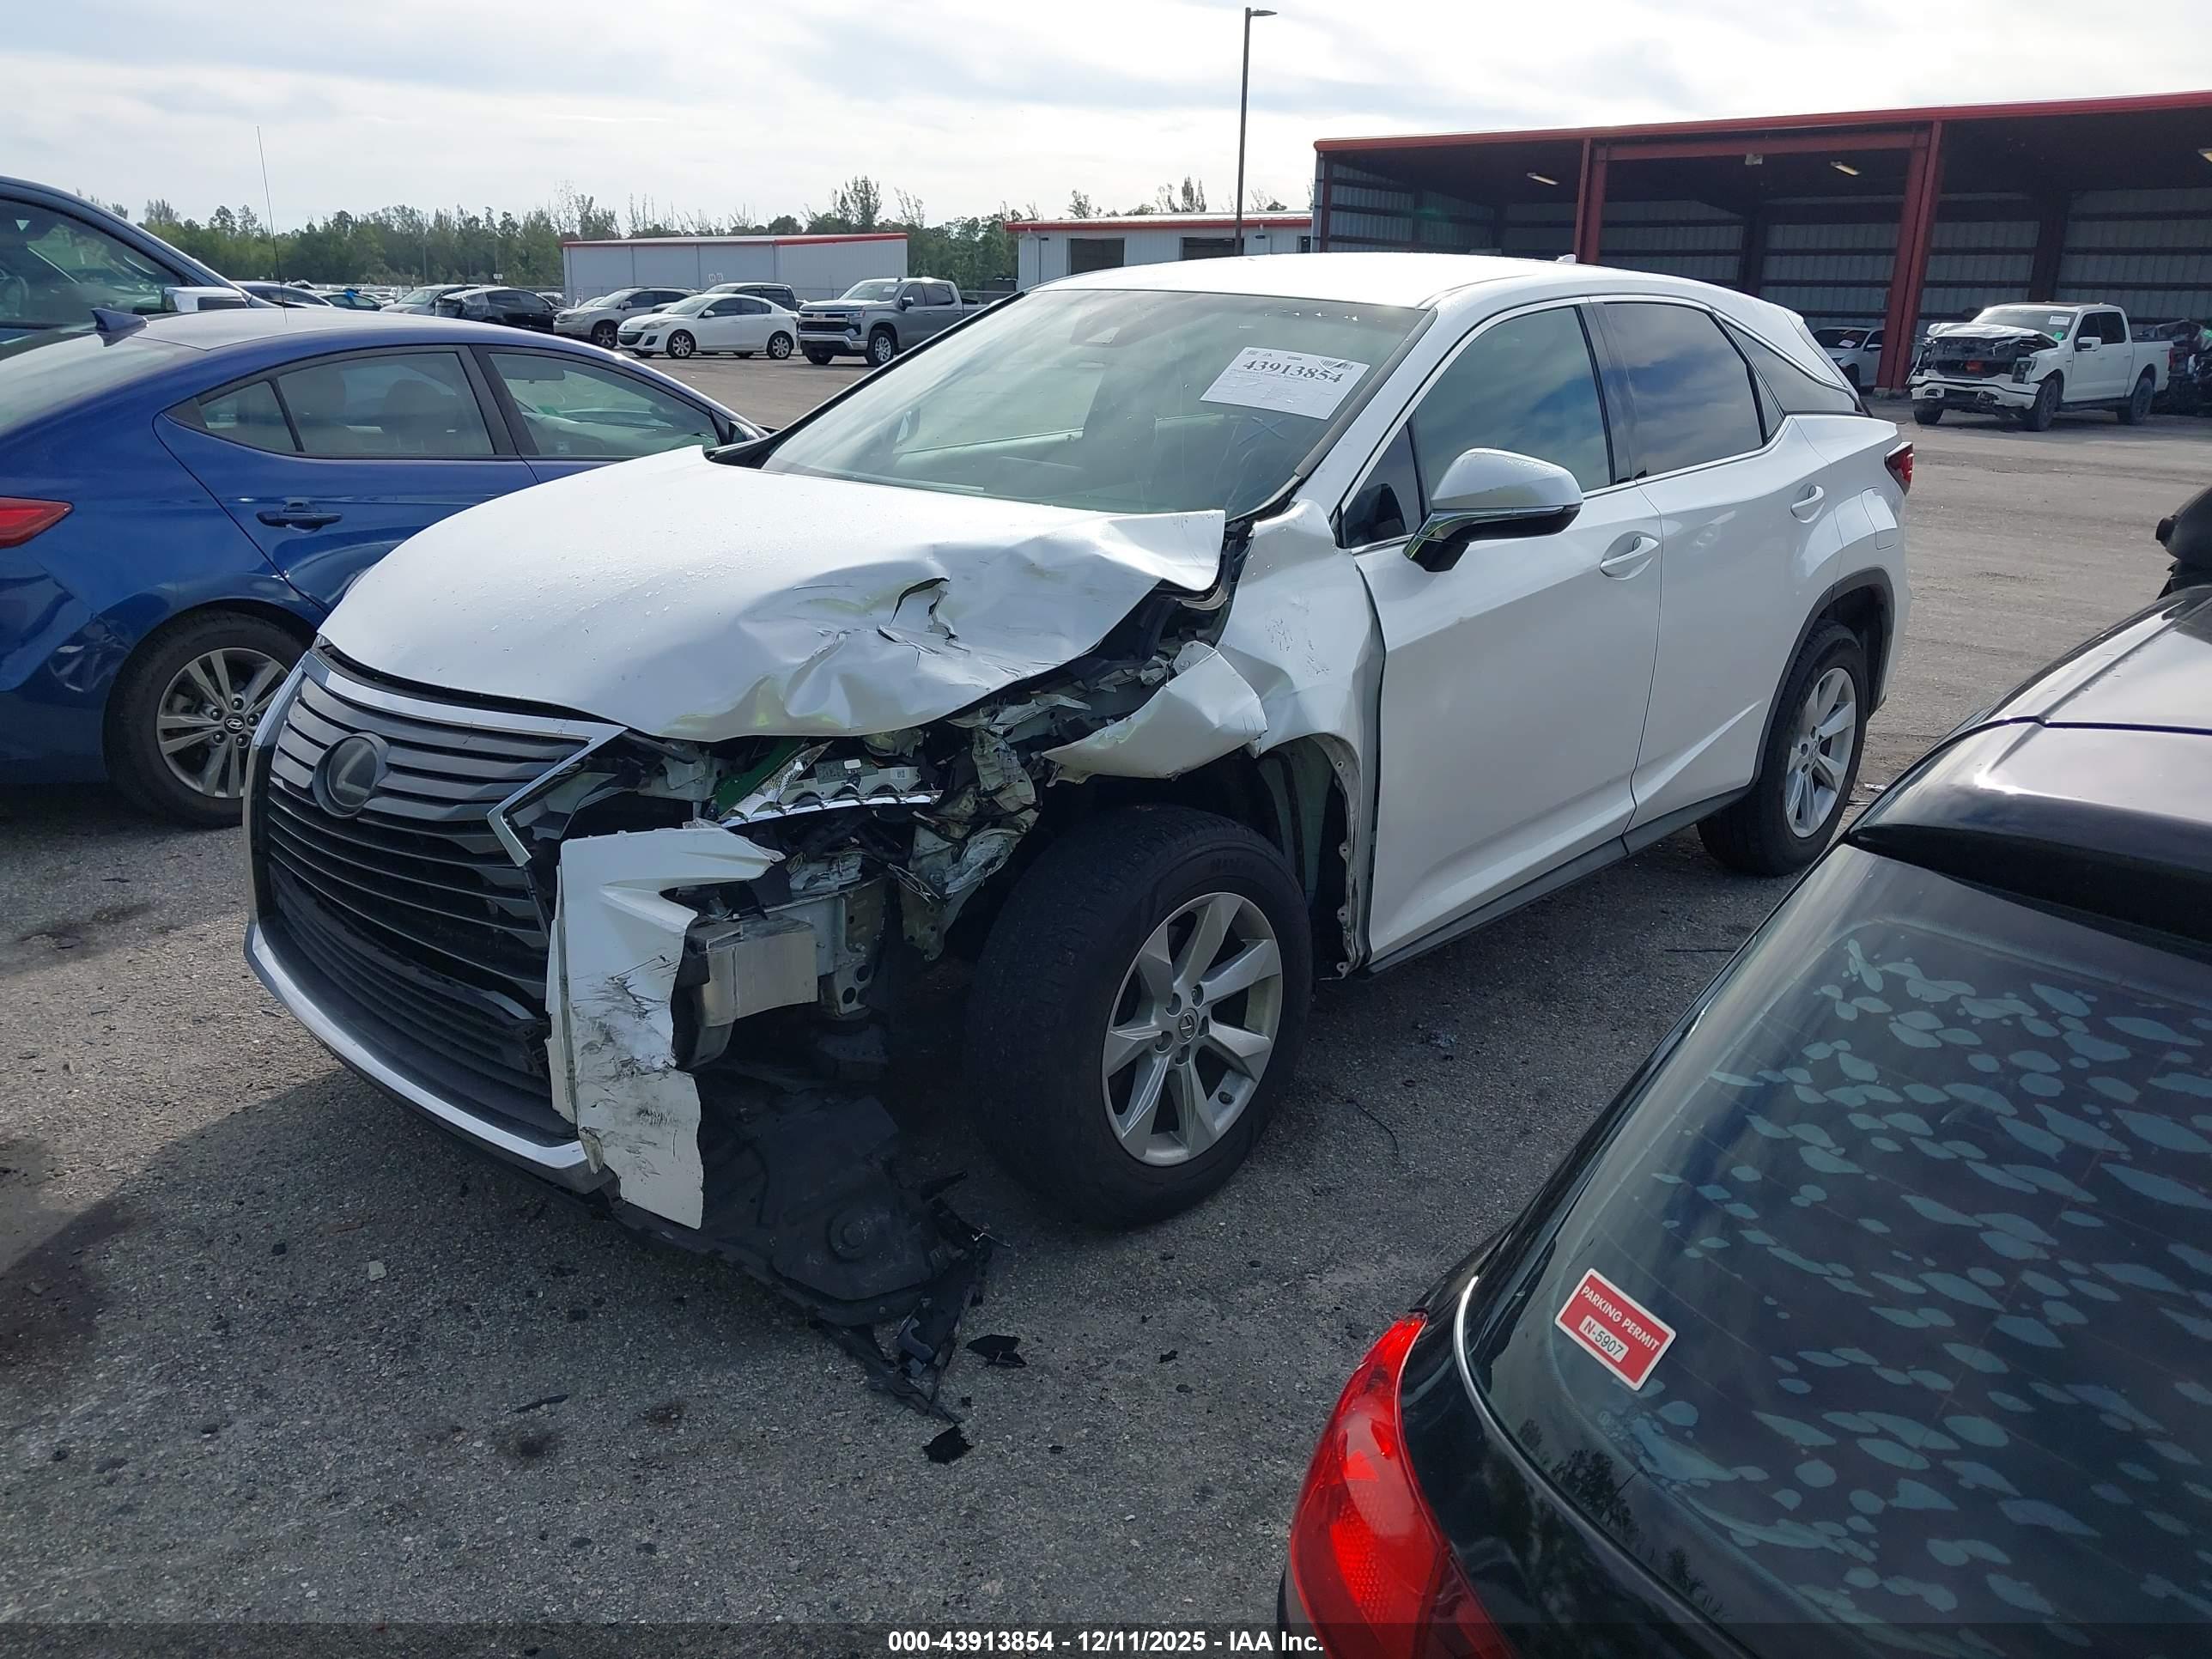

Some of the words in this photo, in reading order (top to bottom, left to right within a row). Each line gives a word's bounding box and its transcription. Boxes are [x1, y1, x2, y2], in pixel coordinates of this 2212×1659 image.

[1243, 359, 1345, 383] 43913854
[1580, 1285, 1623, 1322] PARKING
[1621, 1317, 1661, 1352] PERMIT
[1583, 1320, 1624, 1357] N-5907
